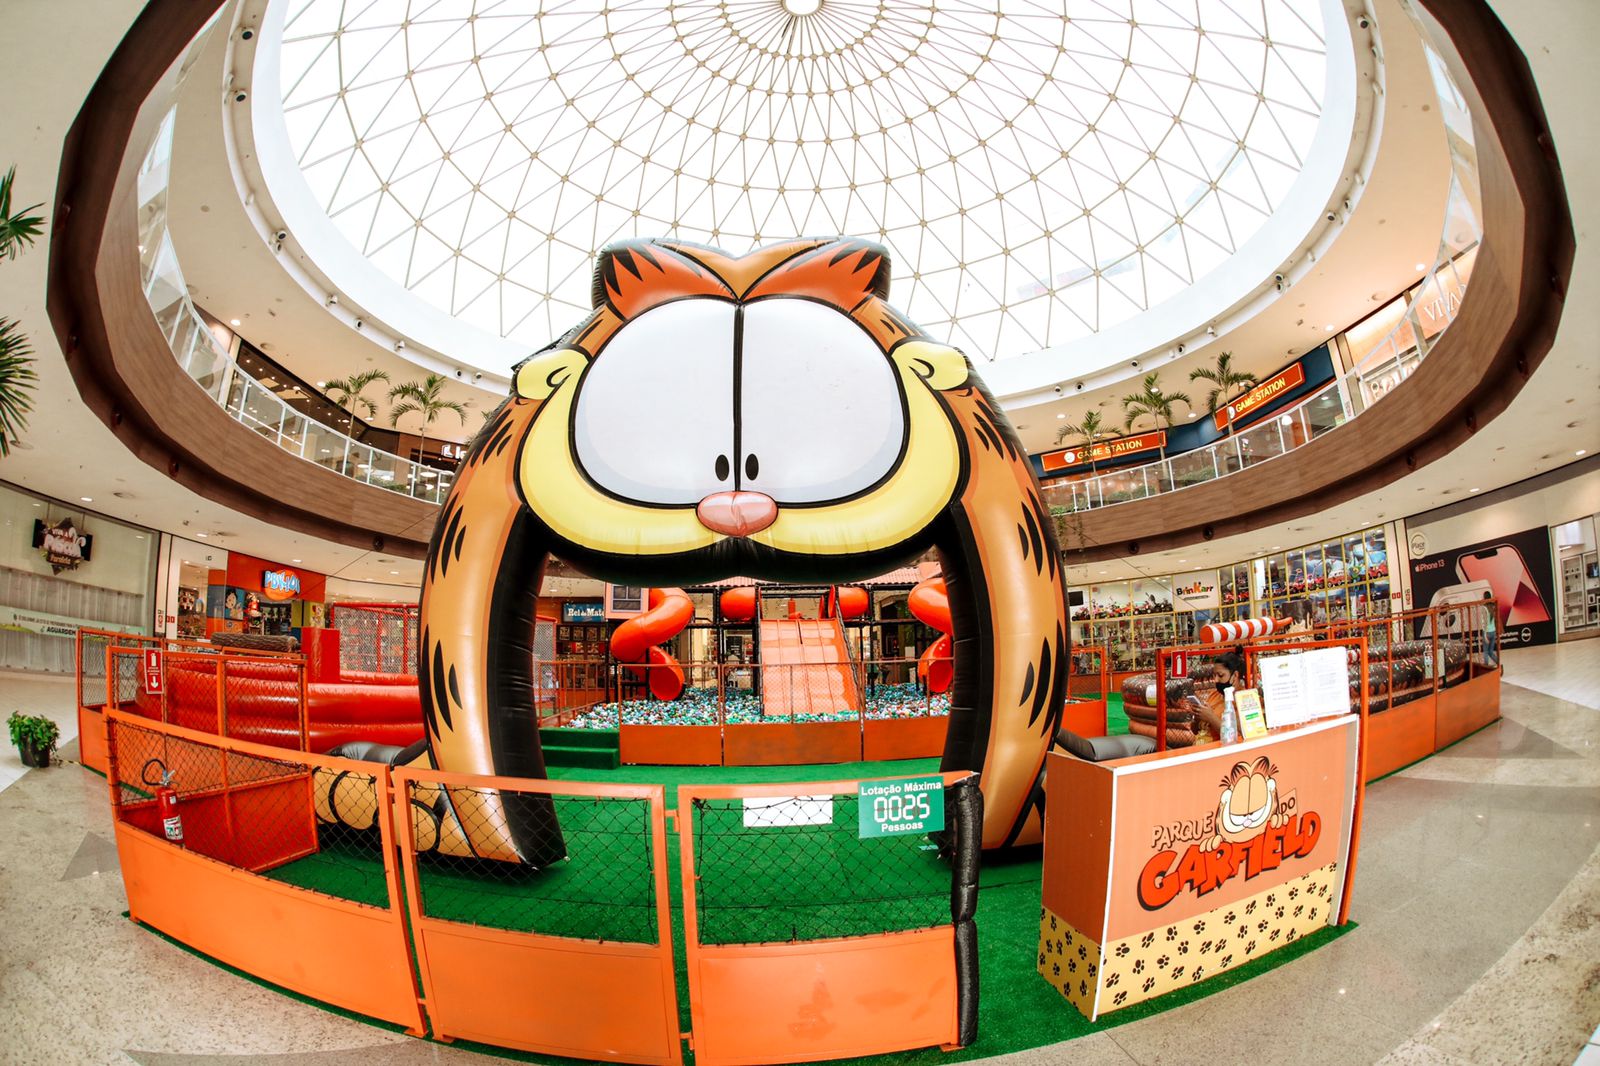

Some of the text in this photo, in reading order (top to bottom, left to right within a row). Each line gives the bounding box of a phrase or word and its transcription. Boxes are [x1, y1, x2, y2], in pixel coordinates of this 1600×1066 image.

[1235, 377, 1286, 412] GAME STATION
[1076, 439, 1143, 460] GAME STATION
[861, 781, 942, 796] Lotação Máxima
[873, 793, 930, 823] 0025
[881, 822, 924, 833] Pessoas
[1150, 796, 1297, 852] PARQUE DO
[1136, 810, 1322, 912] GARFIELD
